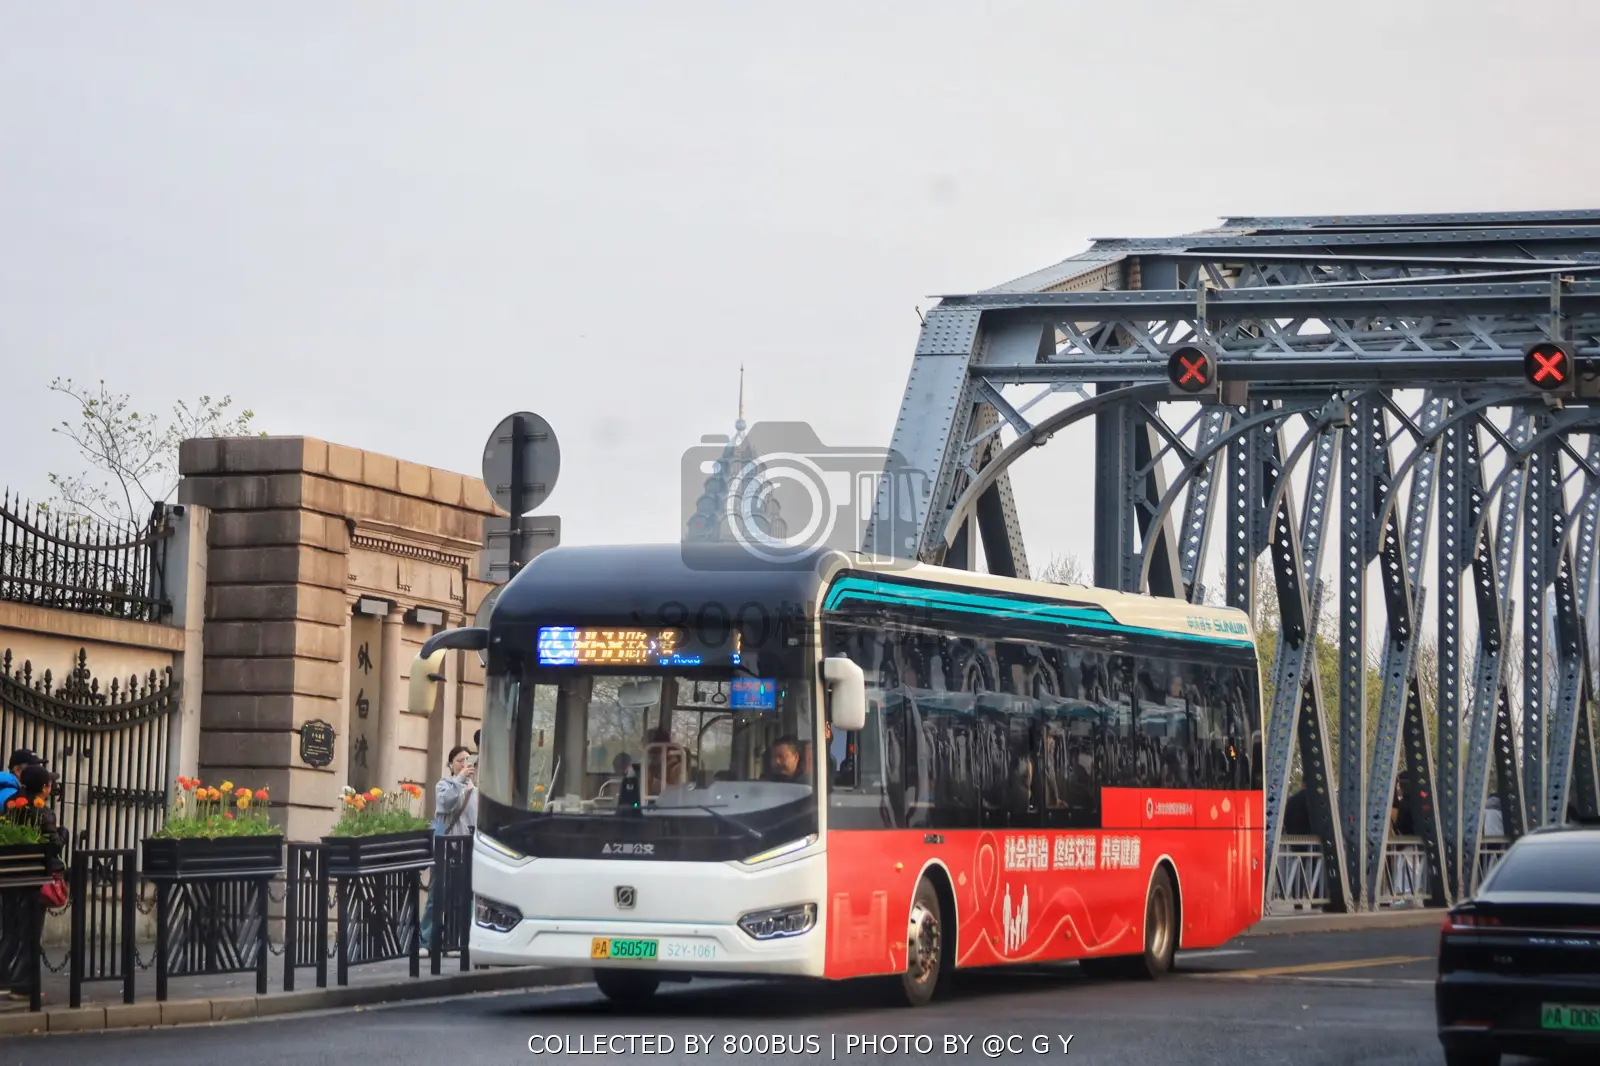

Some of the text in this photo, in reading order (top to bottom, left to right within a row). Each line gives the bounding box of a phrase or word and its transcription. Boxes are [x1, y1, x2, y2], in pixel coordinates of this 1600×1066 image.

[1213, 619, 1249, 635] SUNWIN
[613, 941, 657, 957] 56057D
[667, 943, 717, 959] S2Y-1061
[1570, 1008, 1600, 1027] D06
